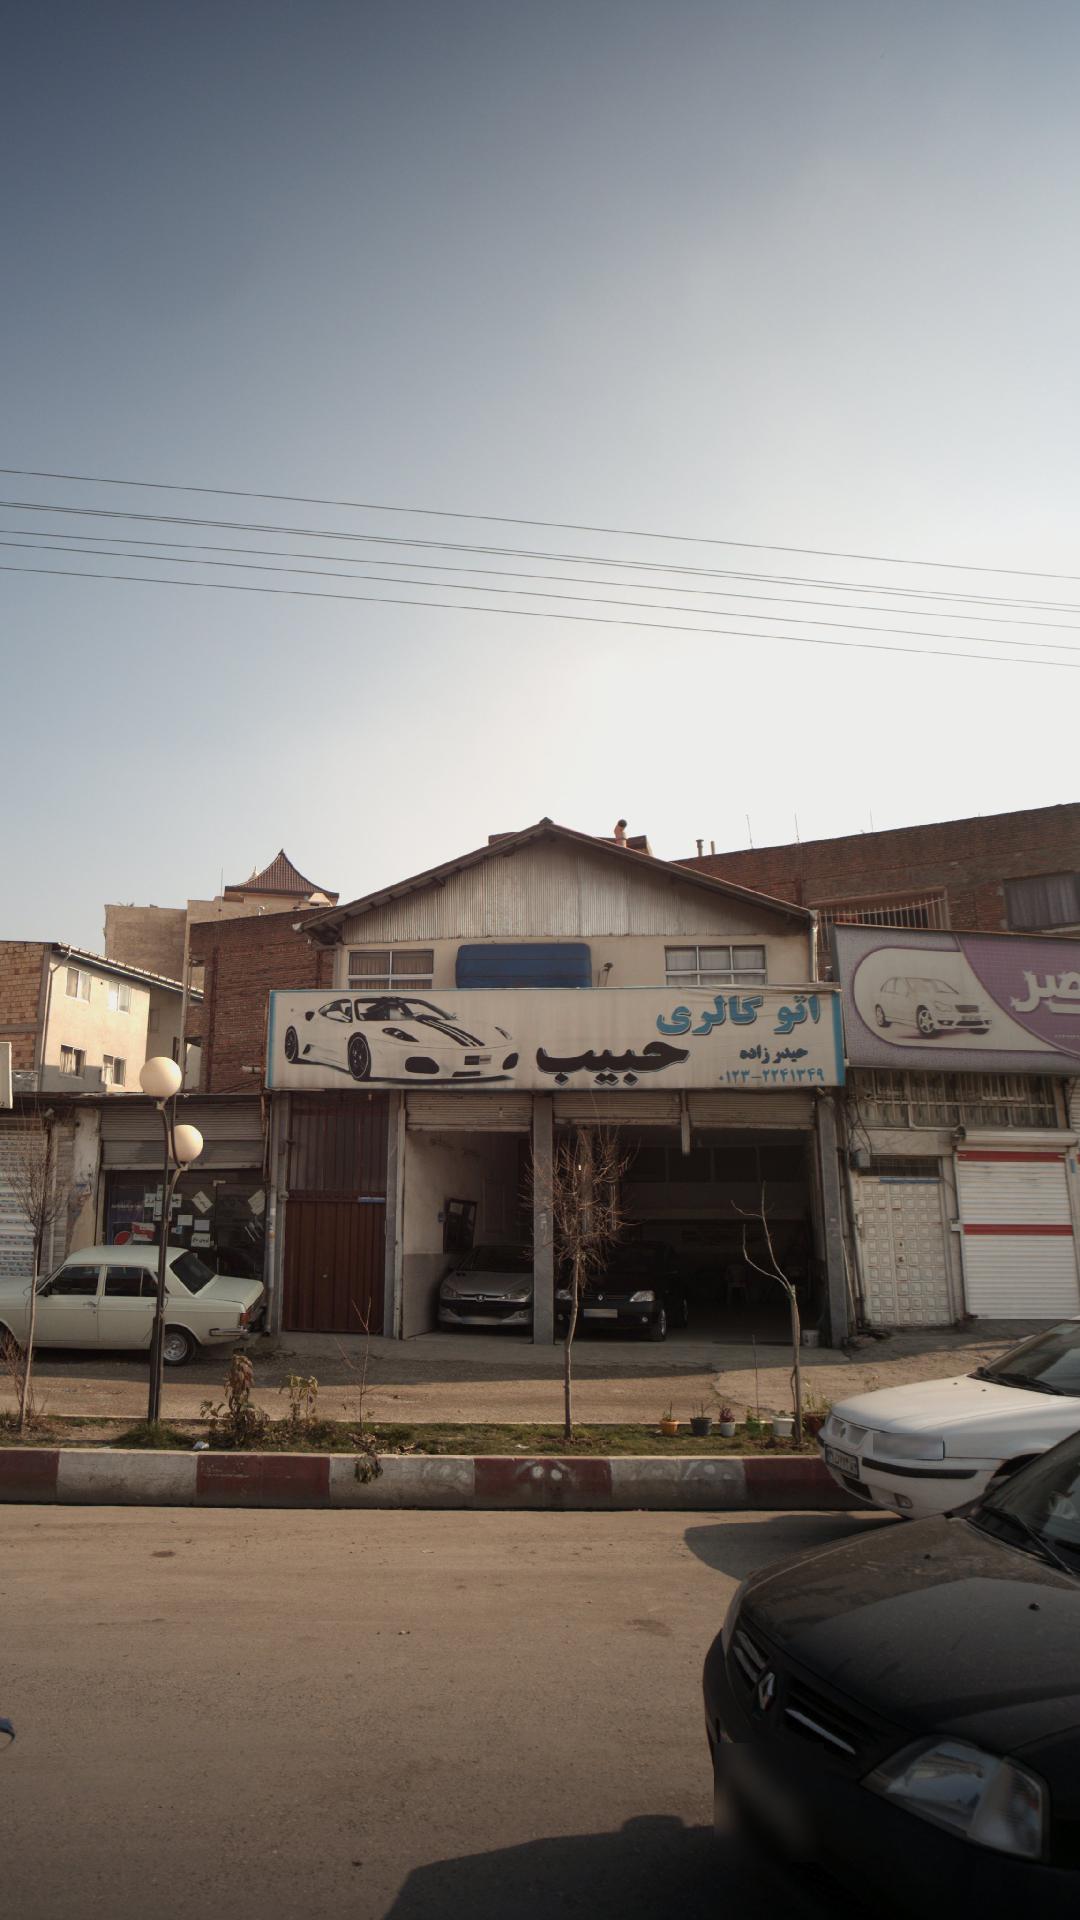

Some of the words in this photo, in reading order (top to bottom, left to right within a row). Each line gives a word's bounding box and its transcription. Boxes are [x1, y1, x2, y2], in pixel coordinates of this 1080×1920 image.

[656, 995, 764, 1036] گالری
[773, 994, 821, 1034] اتو
[536, 1041, 690, 1086] حبیب
